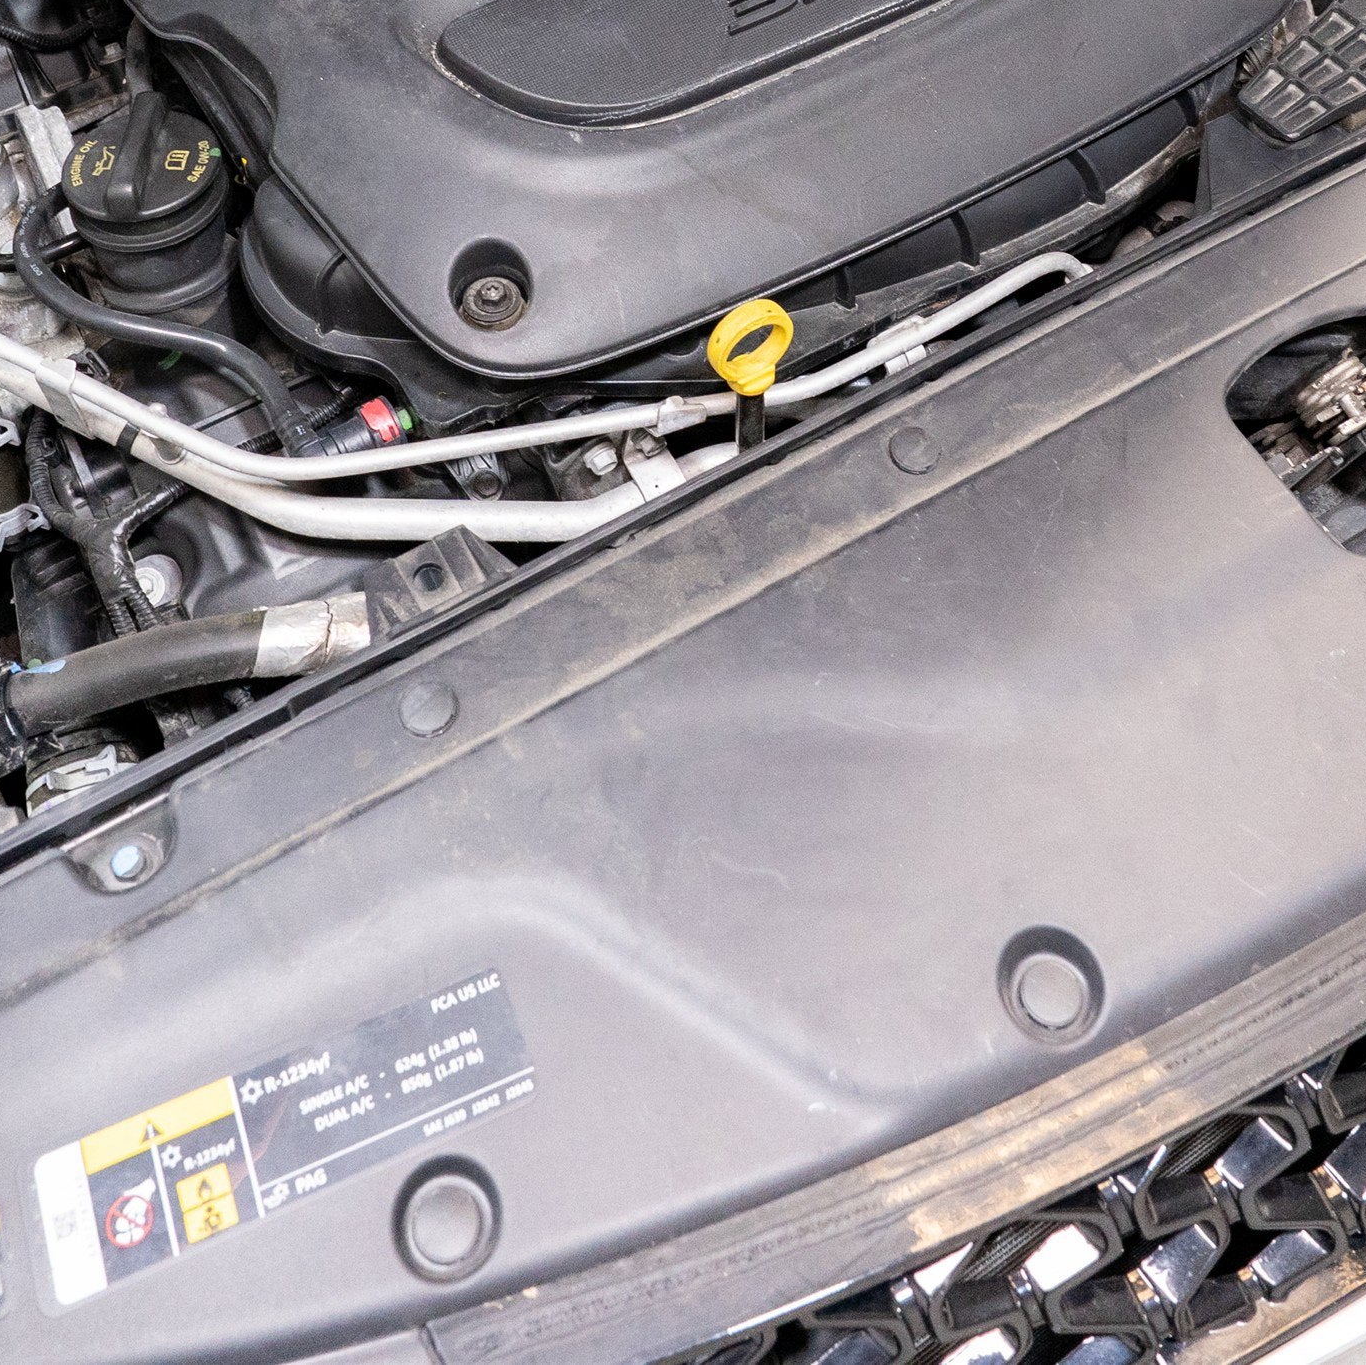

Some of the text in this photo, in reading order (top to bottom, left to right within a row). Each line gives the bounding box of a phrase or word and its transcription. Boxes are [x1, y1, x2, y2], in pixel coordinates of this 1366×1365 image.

[69, 139, 98, 186] ENGINE OIL
[186, 140, 210, 182] SAE 0W-20
[430, 972, 501, 1013] FCA US LLC
[262, 1051, 332, 1093] R-1234yf
[298, 1083, 346, 1114] SINGLE
[343, 1073, 370, 1095] A/C
[314, 1104, 351, 1132] DUAL
[348, 1094, 376, 1118] A/C
[294, 1167, 328, 1194] PAG
